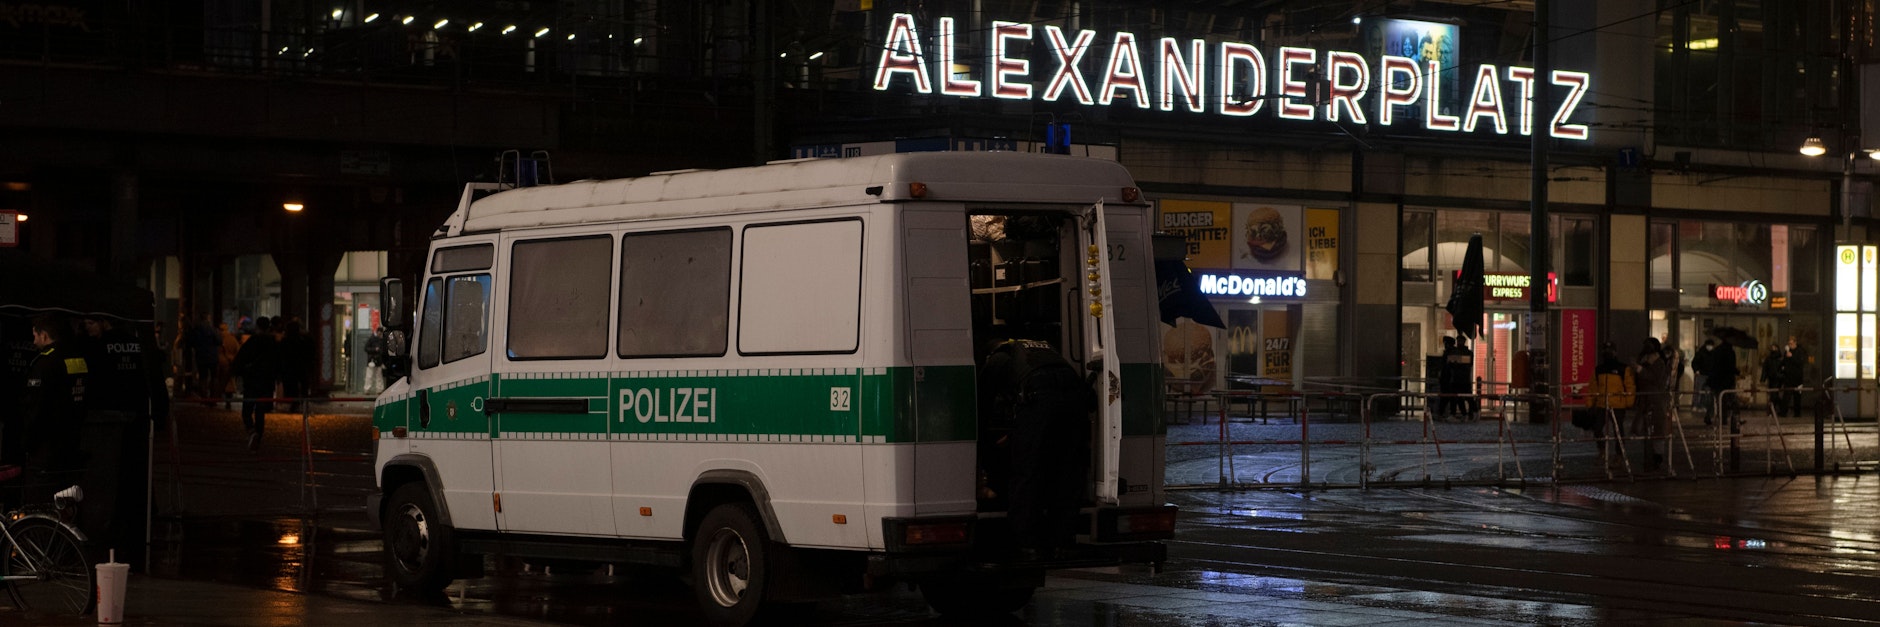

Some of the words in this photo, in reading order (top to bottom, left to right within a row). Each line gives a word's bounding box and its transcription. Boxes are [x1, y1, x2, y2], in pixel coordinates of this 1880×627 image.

[873, 12, 1590, 141] ALEXANDERPLATZ
[1164, 211, 1213, 227] BURGER
[1187, 228, 1227, 241] MITTE?
[1309, 226, 1325, 238] ICH
[1309, 238, 1336, 249] LIEBE
[1200, 274, 1307, 297] McDonald's
[1483, 274, 1531, 287] URRYWURS
[1493, 287, 1522, 298] EXPRESS
[1266, 337, 1289, 350] 24/7
[1571, 313, 1580, 382] CURRYWURST
[1266, 352, 1290, 367] FÜR
[618, 387, 717, 423] POLIZEI
[832, 390, 849, 408] 32
